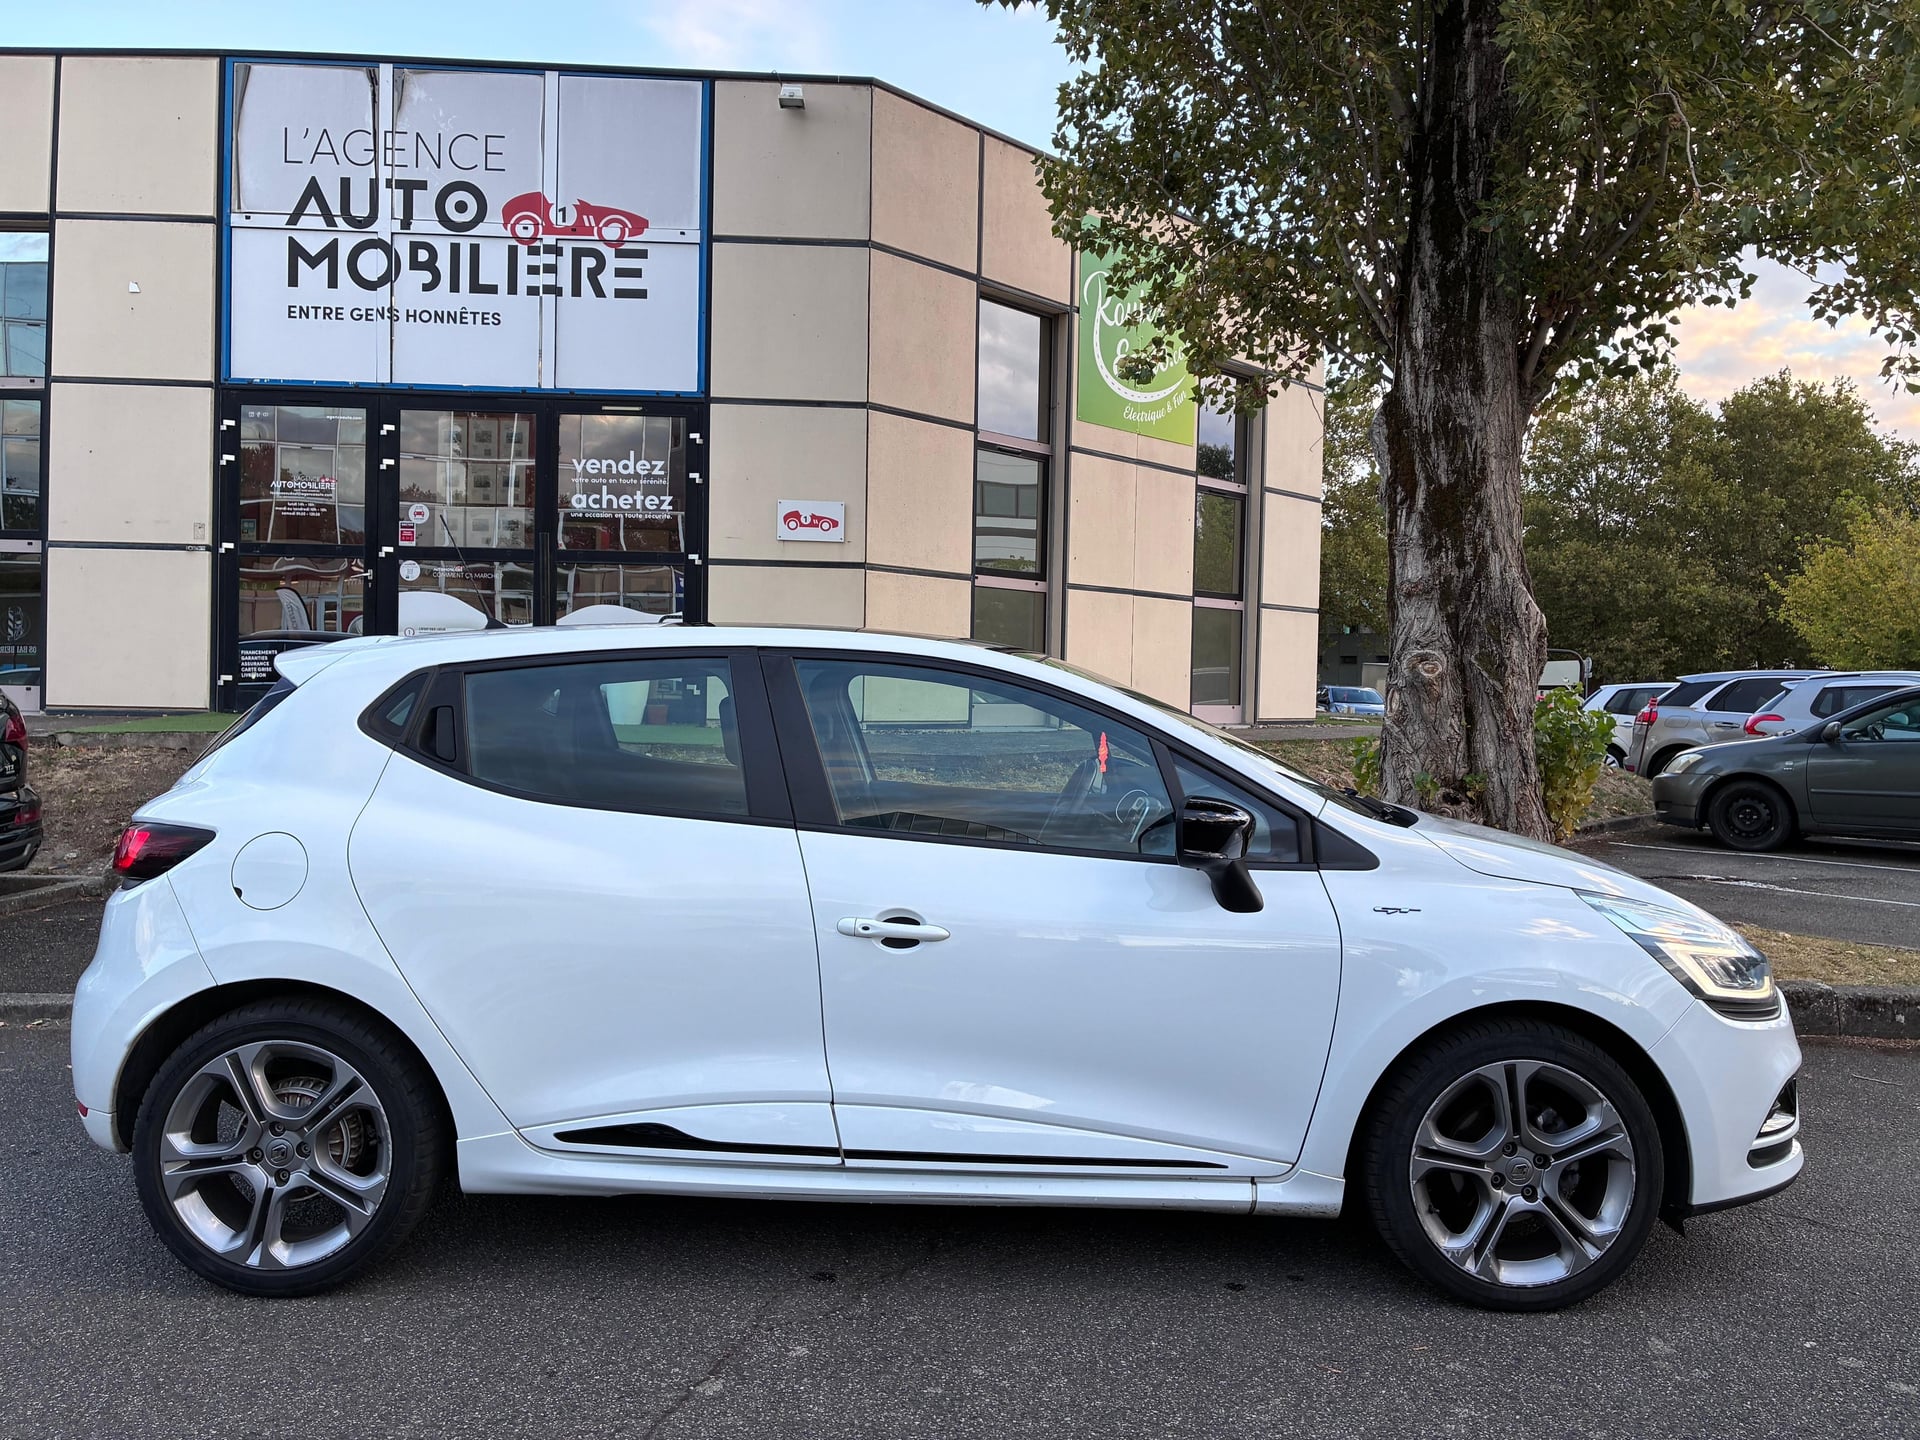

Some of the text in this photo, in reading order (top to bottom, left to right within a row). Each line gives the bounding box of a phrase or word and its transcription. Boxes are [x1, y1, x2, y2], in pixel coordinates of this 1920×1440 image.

[284, 127, 506, 172] L'AGENCE
[285, 175, 488, 233] AUTO
[557, 206, 567, 223] 1
[287, 305, 502, 326] ENTRE GENS HONNÊTES
[1166, 400, 1172, 413] &
[1172, 390, 1187, 408] Fun
[571, 450, 665, 475] vendez
[571, 485, 673, 510] achetez
